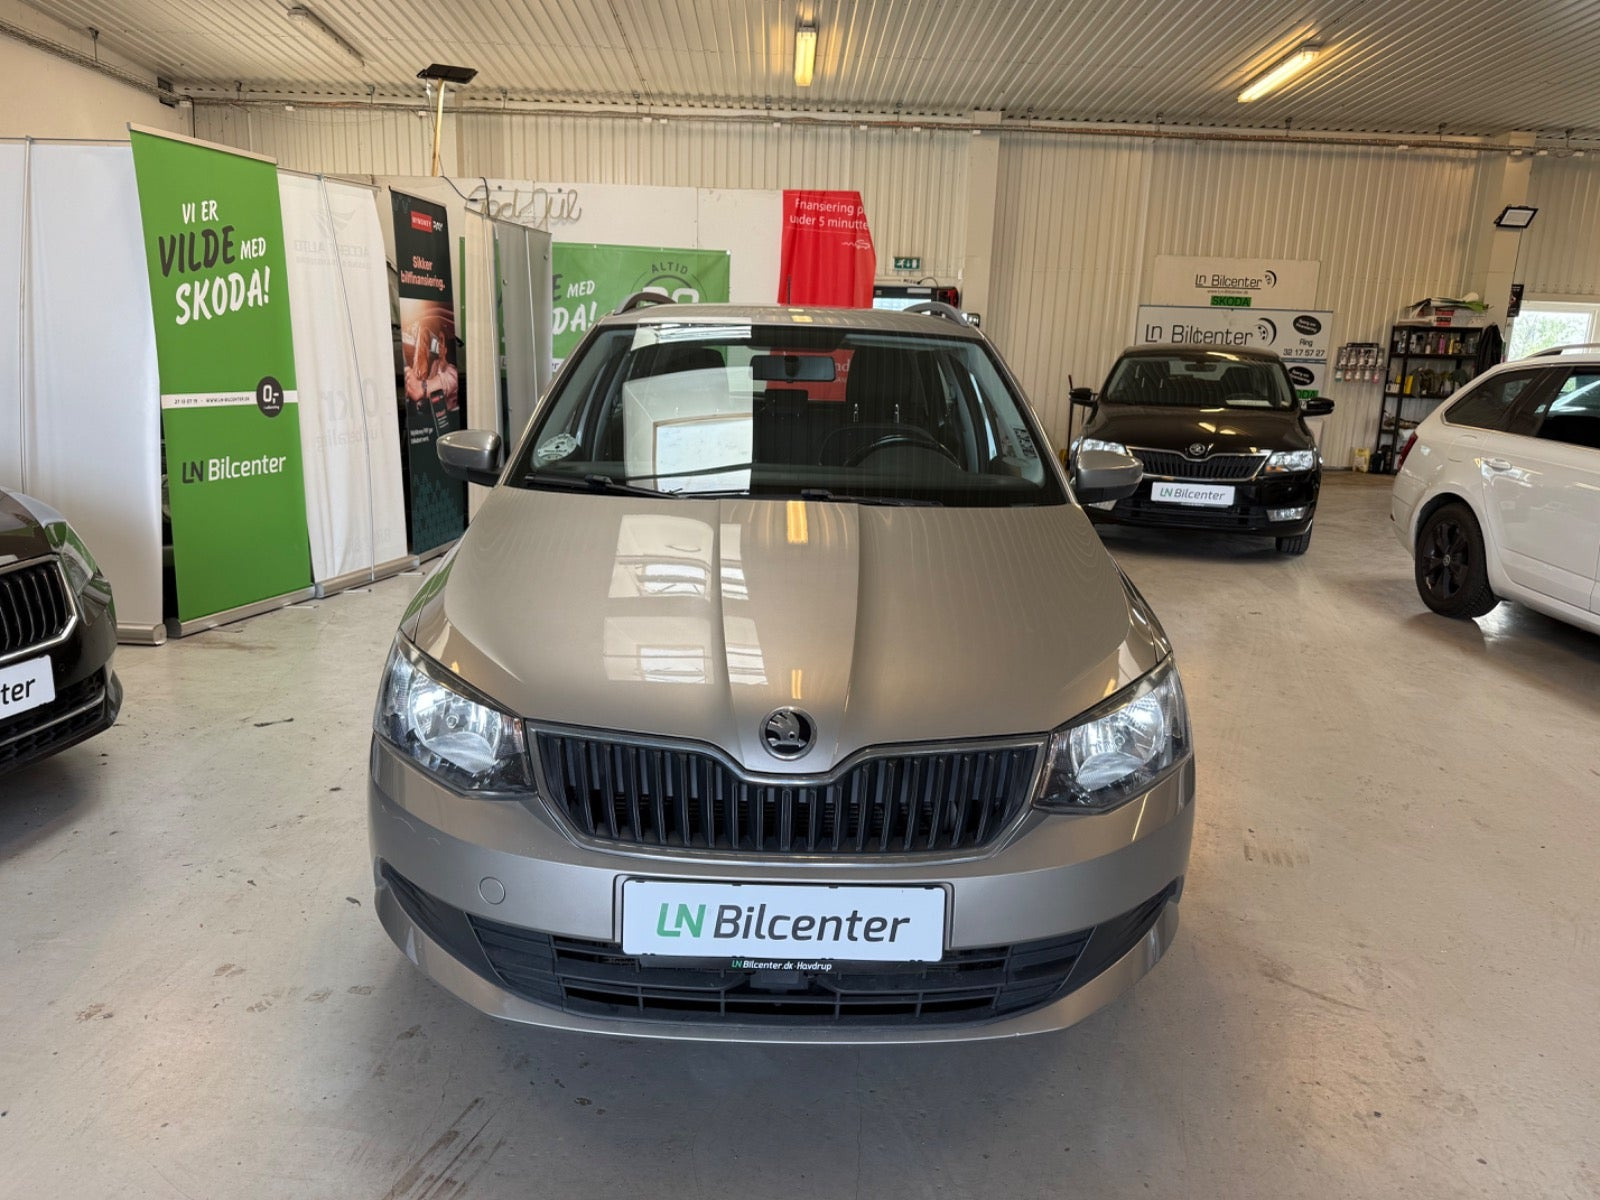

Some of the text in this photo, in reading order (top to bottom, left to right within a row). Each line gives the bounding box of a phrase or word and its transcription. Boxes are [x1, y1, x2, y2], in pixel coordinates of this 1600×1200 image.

[182, 200, 219, 224] VI ER
[818, 216, 826, 227] 5
[158, 225, 266, 277] VILDE MED
[412, 255, 433, 271] Sikker
[651, 262, 688, 275] ALTID
[567, 280, 596, 299] MED
[1211, 274, 1263, 288] Bilcenter
[175, 265, 270, 325] SKODA!
[1211, 295, 1251, 307] SKODA
[1171, 325, 1253, 346] Bilcenter
[1299, 338, 1314, 347] Ring
[263, 384, 280, 404] 0,-
[182, 456, 286, 484] LN Bilcenter
[1160, 487, 1226, 501] LN Bilcenter
[656, 902, 910, 942] LN Bilcenter
[743, 960, 793, 970] Bilcenter.dk
[796, 961, 832, 972] Havdrup
